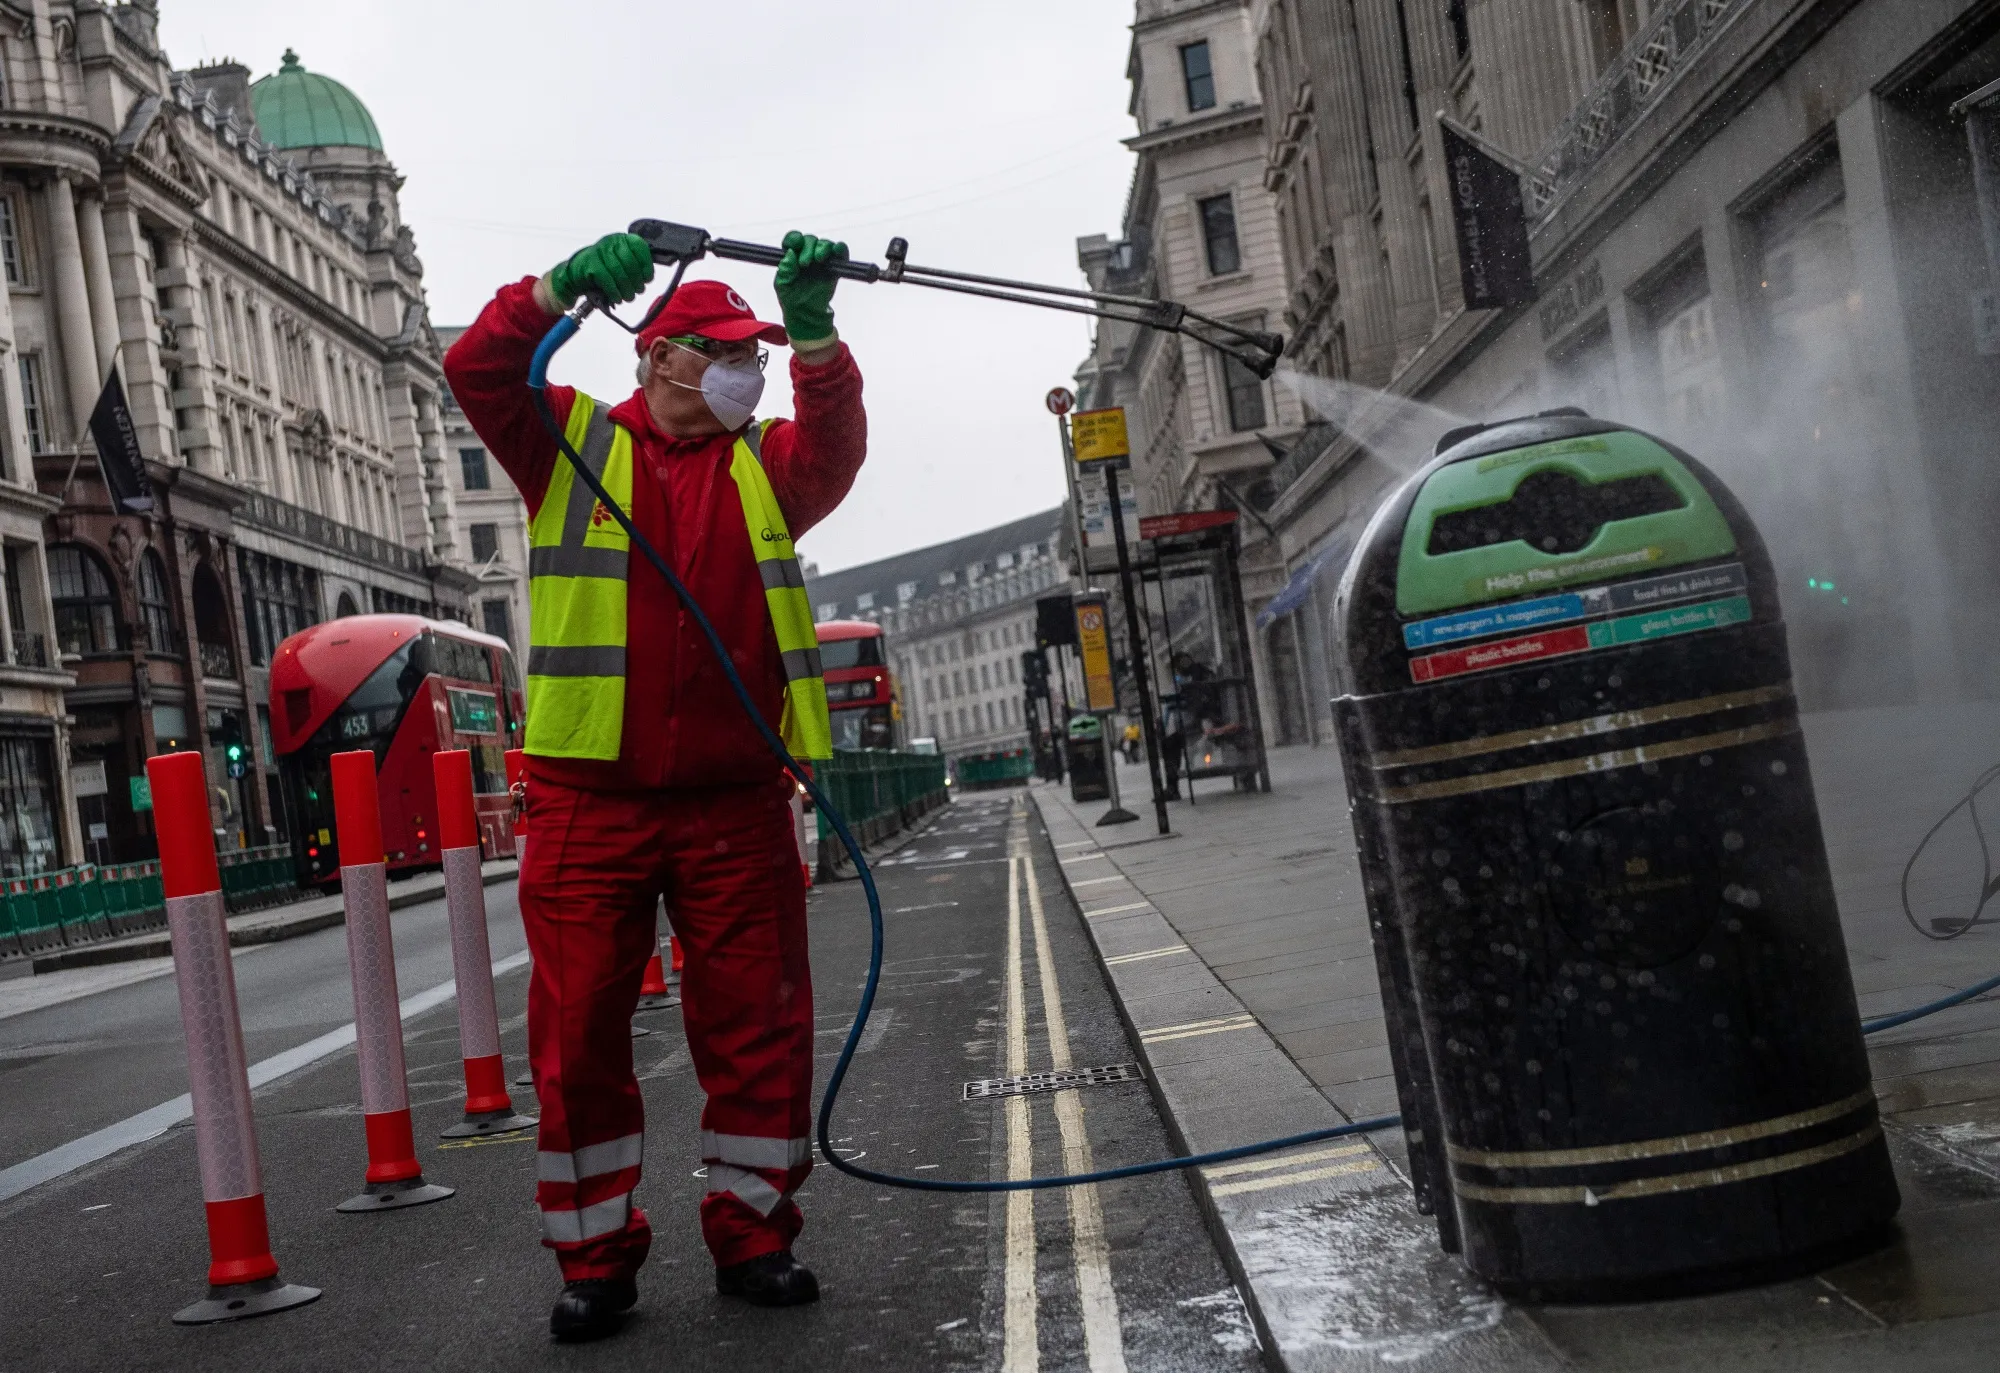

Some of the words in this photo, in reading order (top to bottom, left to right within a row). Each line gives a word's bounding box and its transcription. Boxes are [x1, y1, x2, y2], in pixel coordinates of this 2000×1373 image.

[1454, 154, 1475, 210] KORS
[1463, 215, 1489, 299] MICHAEL
[1097, 415, 1118, 425] stop
[1486, 572, 1525, 591] Help
[1527, 568, 1556, 582] the
[1557, 548, 1650, 577] environment
[1633, 587, 1659, 601] food
[1660, 584, 1678, 597] tins
[1679, 581, 1688, 593] &
[1689, 577, 1711, 590] drink
[1495, 613, 1505, 624] &
[1641, 618, 1670, 635] glass
[1670, 610, 1706, 626] bottles
[1708, 608, 1716, 619] &
[1466, 648, 1500, 667] plastic
[1500, 641, 1545, 659] bottles
[343, 714, 369, 737] 453
